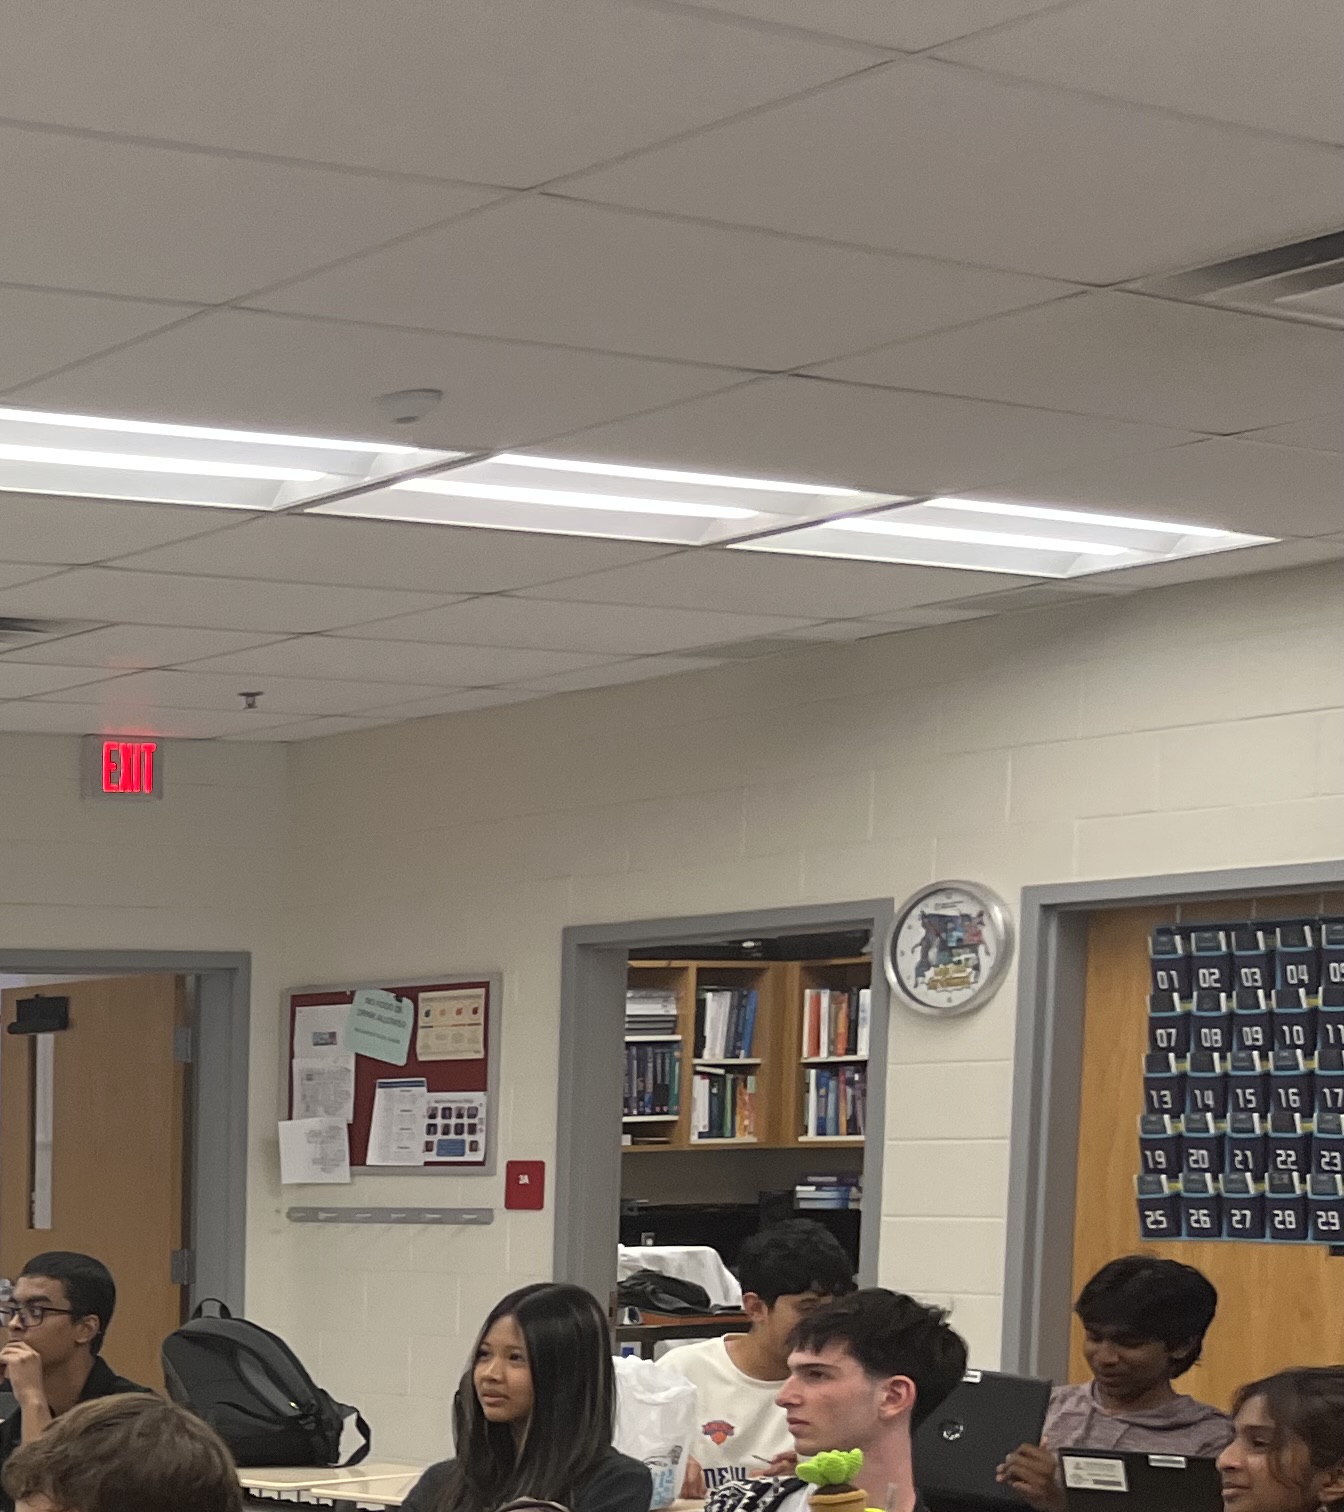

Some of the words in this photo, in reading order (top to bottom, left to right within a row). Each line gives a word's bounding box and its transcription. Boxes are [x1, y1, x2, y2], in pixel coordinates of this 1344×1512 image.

[102, 741, 156, 793] EXIT
[1157, 970, 1179, 989] 01
[1198, 968, 1221, 988] 02
[1240, 968, 1261, 987] 03
[1286, 964, 1309, 984] 04
[1155, 1028, 1177, 1048] 07
[1200, 1028, 1222, 1047] 08
[1242, 1026, 1264, 1046] 09
[1282, 1025, 1304, 1045] 10
[1150, 1089, 1172, 1109] 13
[1194, 1089, 1215, 1109] 14
[1236, 1088, 1257, 1108] 15
[1278, 1088, 1301, 1108] 16
[1322, 1088, 1344, 1108] 17
[1145, 1150, 1167, 1169] 19
[1188, 1149, 1210, 1168] 20
[1234, 1150, 1254, 1169] 21
[1276, 1149, 1298, 1170] 22
[1320, 1150, 1342, 1171] 23
[1144, 1210, 1168, 1229] 25
[1188, 1209, 1211, 1228] 26
[1231, 1209, 1252, 1229] 27
[1273, 1210, 1296, 1229] 28
[1316, 1211, 1340, 1231] 29
